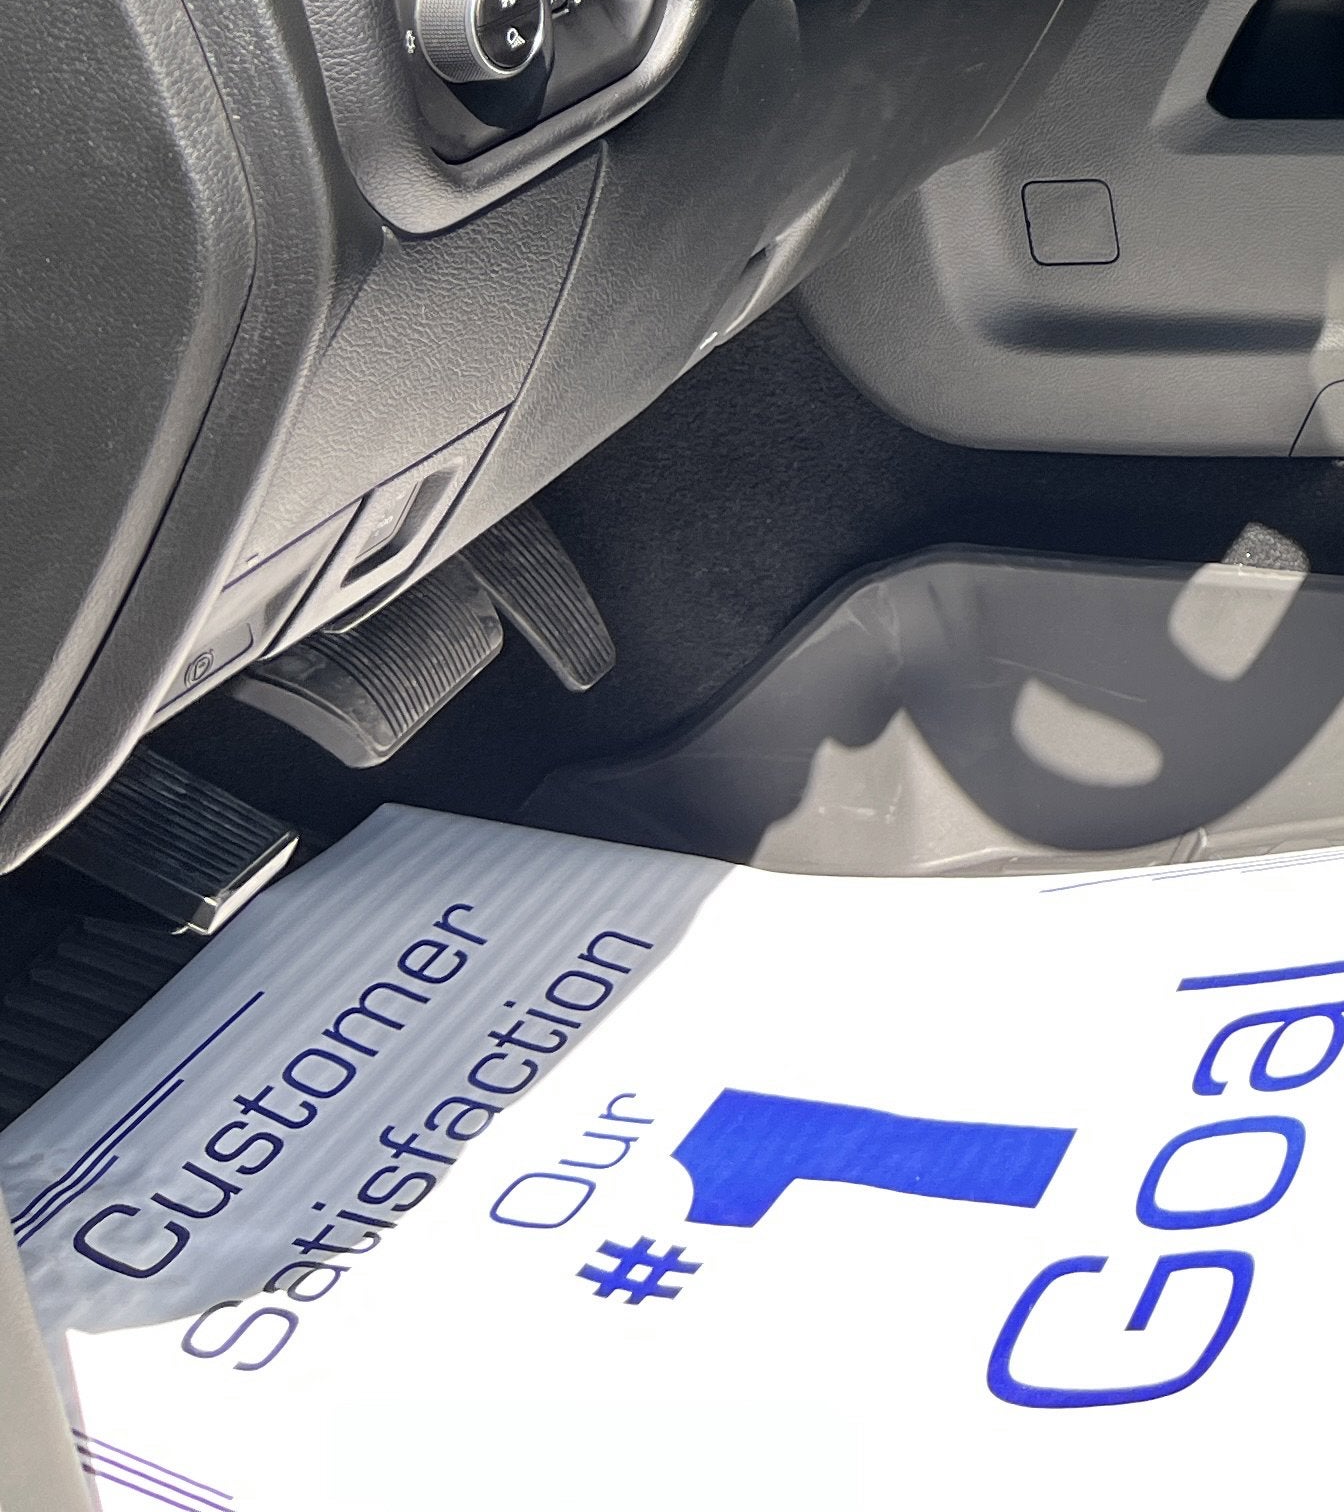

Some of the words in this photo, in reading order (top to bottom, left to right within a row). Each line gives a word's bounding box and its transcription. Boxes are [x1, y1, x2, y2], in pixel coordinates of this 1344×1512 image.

[73, 902, 492, 1279] Customer
[181, 929, 654, 1371] Satisfaction
[489, 1092, 655, 1229] Our
[576, 1087, 1077, 1305] #1
